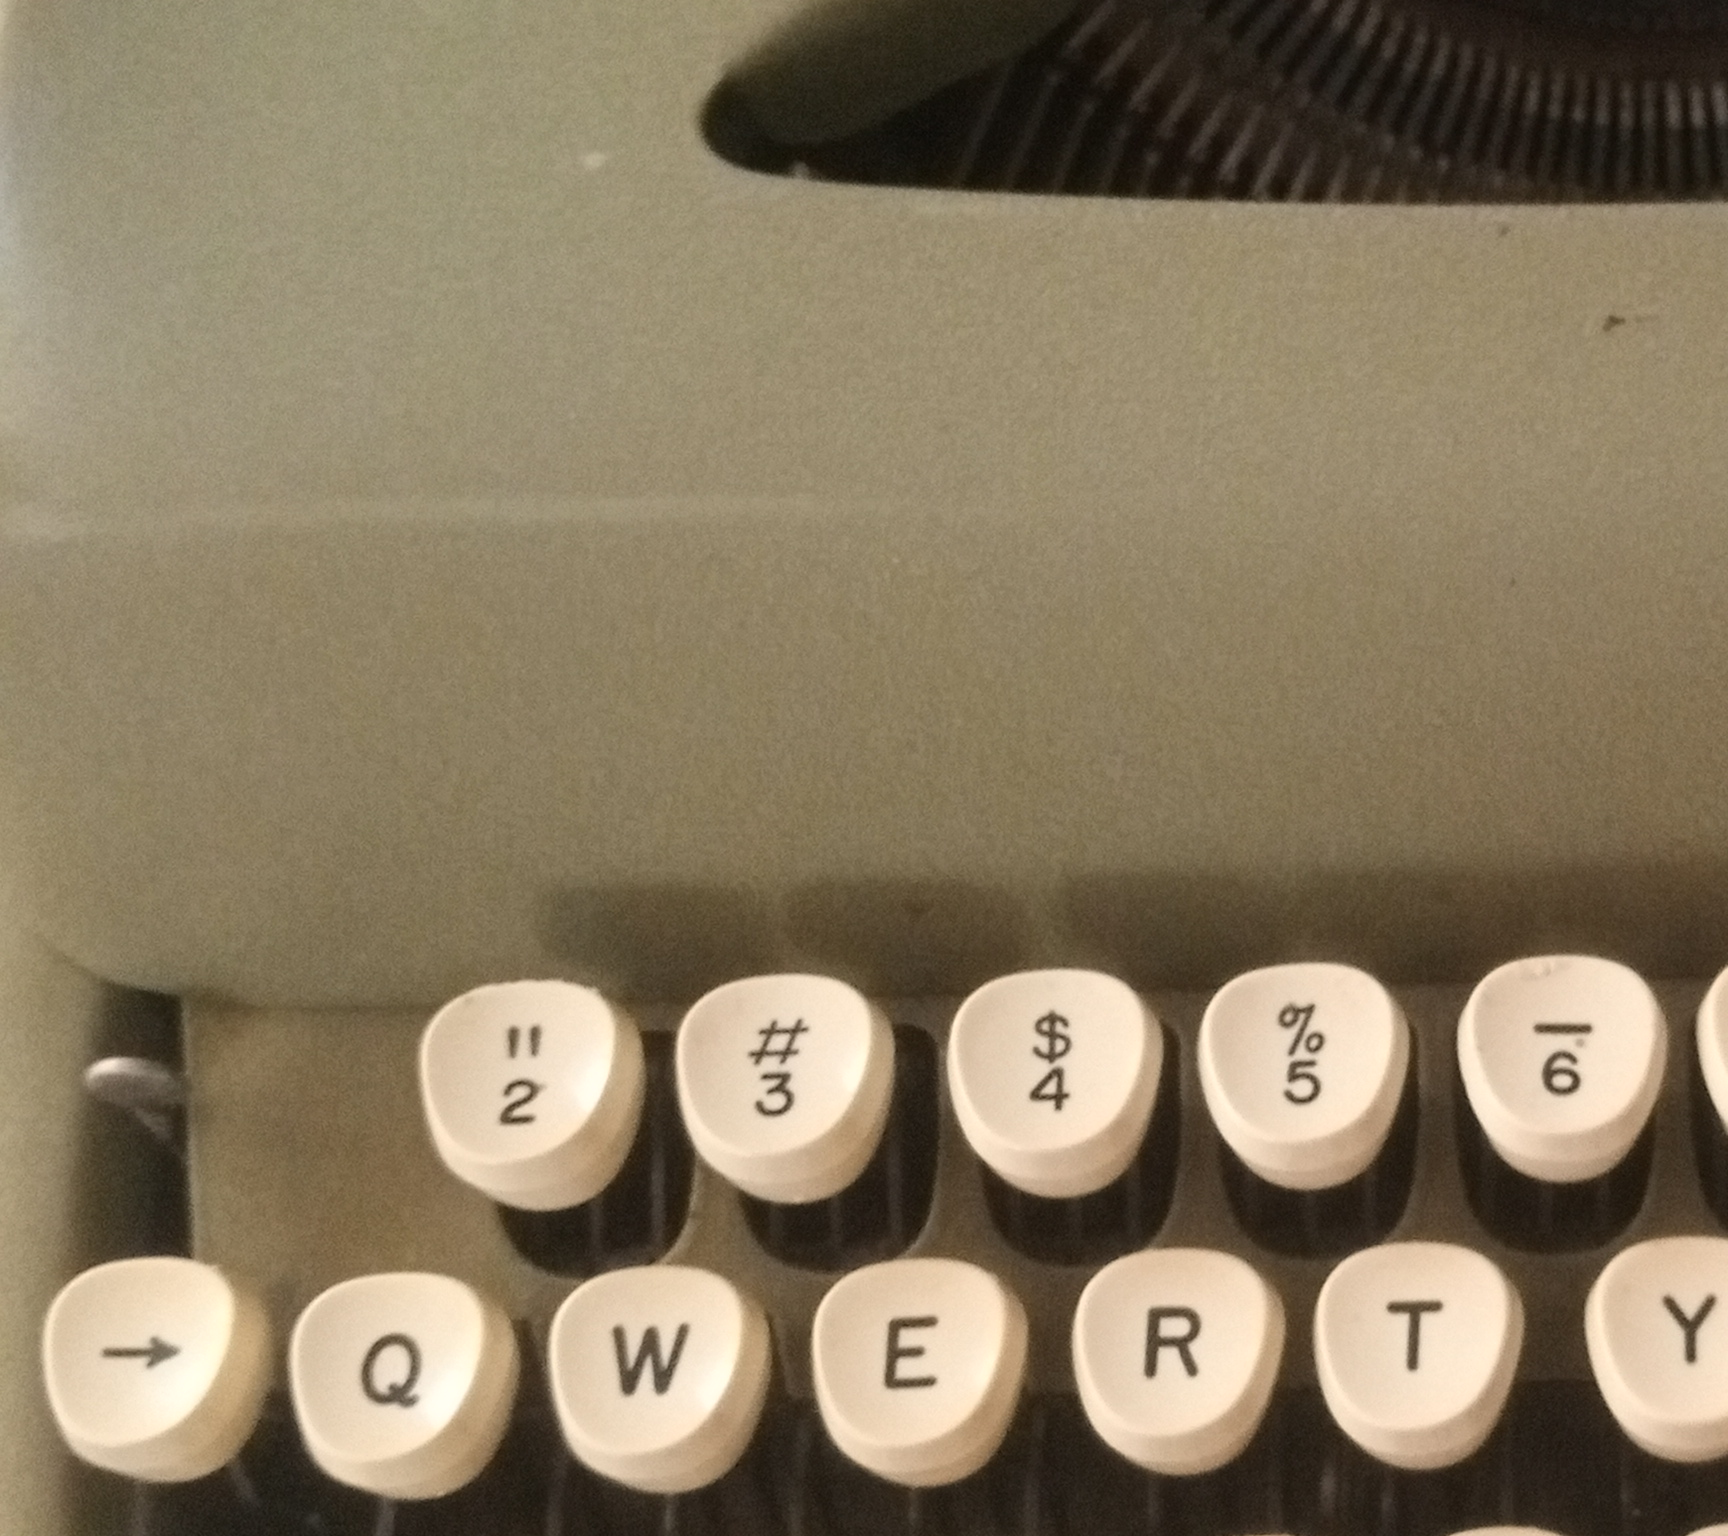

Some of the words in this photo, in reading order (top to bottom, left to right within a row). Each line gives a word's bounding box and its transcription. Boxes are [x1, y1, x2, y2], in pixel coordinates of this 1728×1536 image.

[747, 1017, 811, 1067] #
[1028, 1009, 1073, 1066] $
[1276, 1002, 1327, 1058] %
[753, 1070, 796, 1119] 3
[1028, 1065, 1072, 1113] 4
[1282, 1058, 1323, 1107] 5
[1540, 1049, 1583, 1098] 6
[497, 1077, 545, 1127] 2
[882, 1314, 940, 1391] E
[1142, 1305, 1203, 1381] R
[1385, 1299, 1445, 1373] T
[1661, 1293, 1718, 1366] Y
[358, 1331, 423, 1410] Q
[610, 1322, 691, 1398] W
